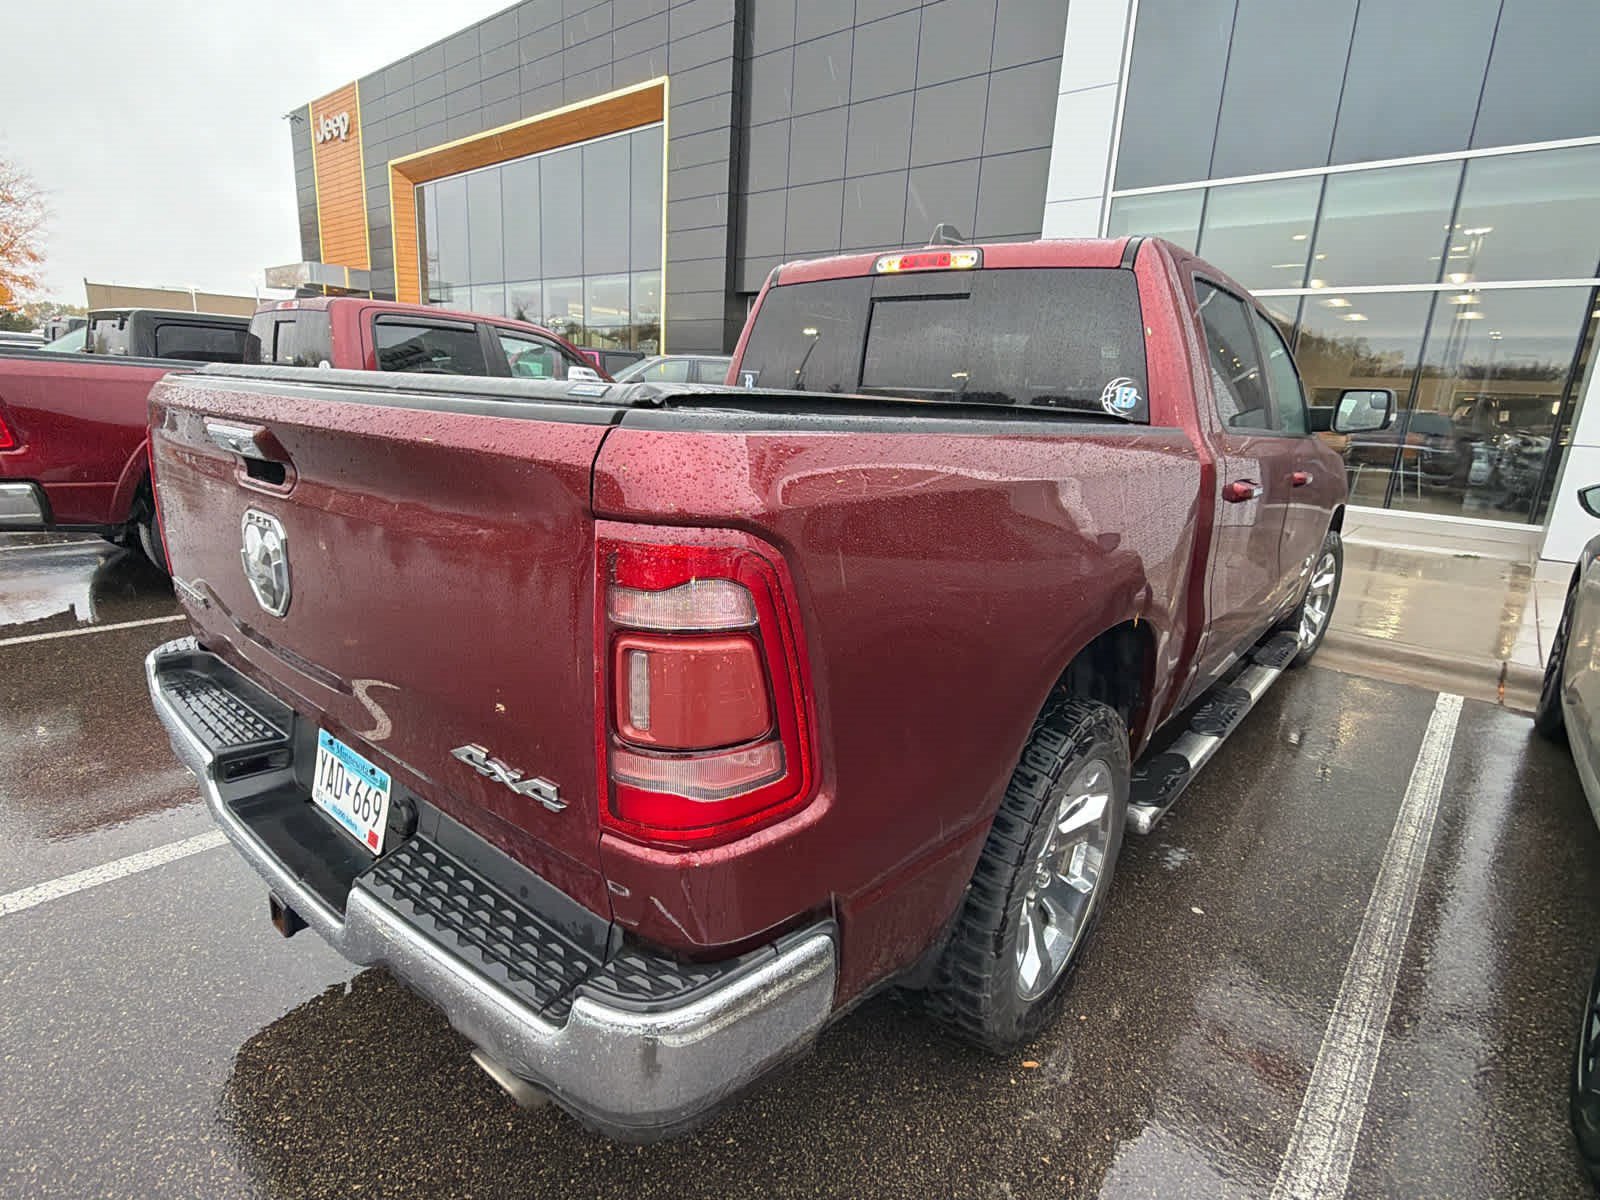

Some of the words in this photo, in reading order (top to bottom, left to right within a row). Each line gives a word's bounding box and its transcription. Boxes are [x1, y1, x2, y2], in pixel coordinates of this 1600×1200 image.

[316, 111, 350, 144] Jeep
[336, 741, 371, 776] Minnesota
[319, 749, 345, 801] YAD
[352, 779, 383, 829] 669
